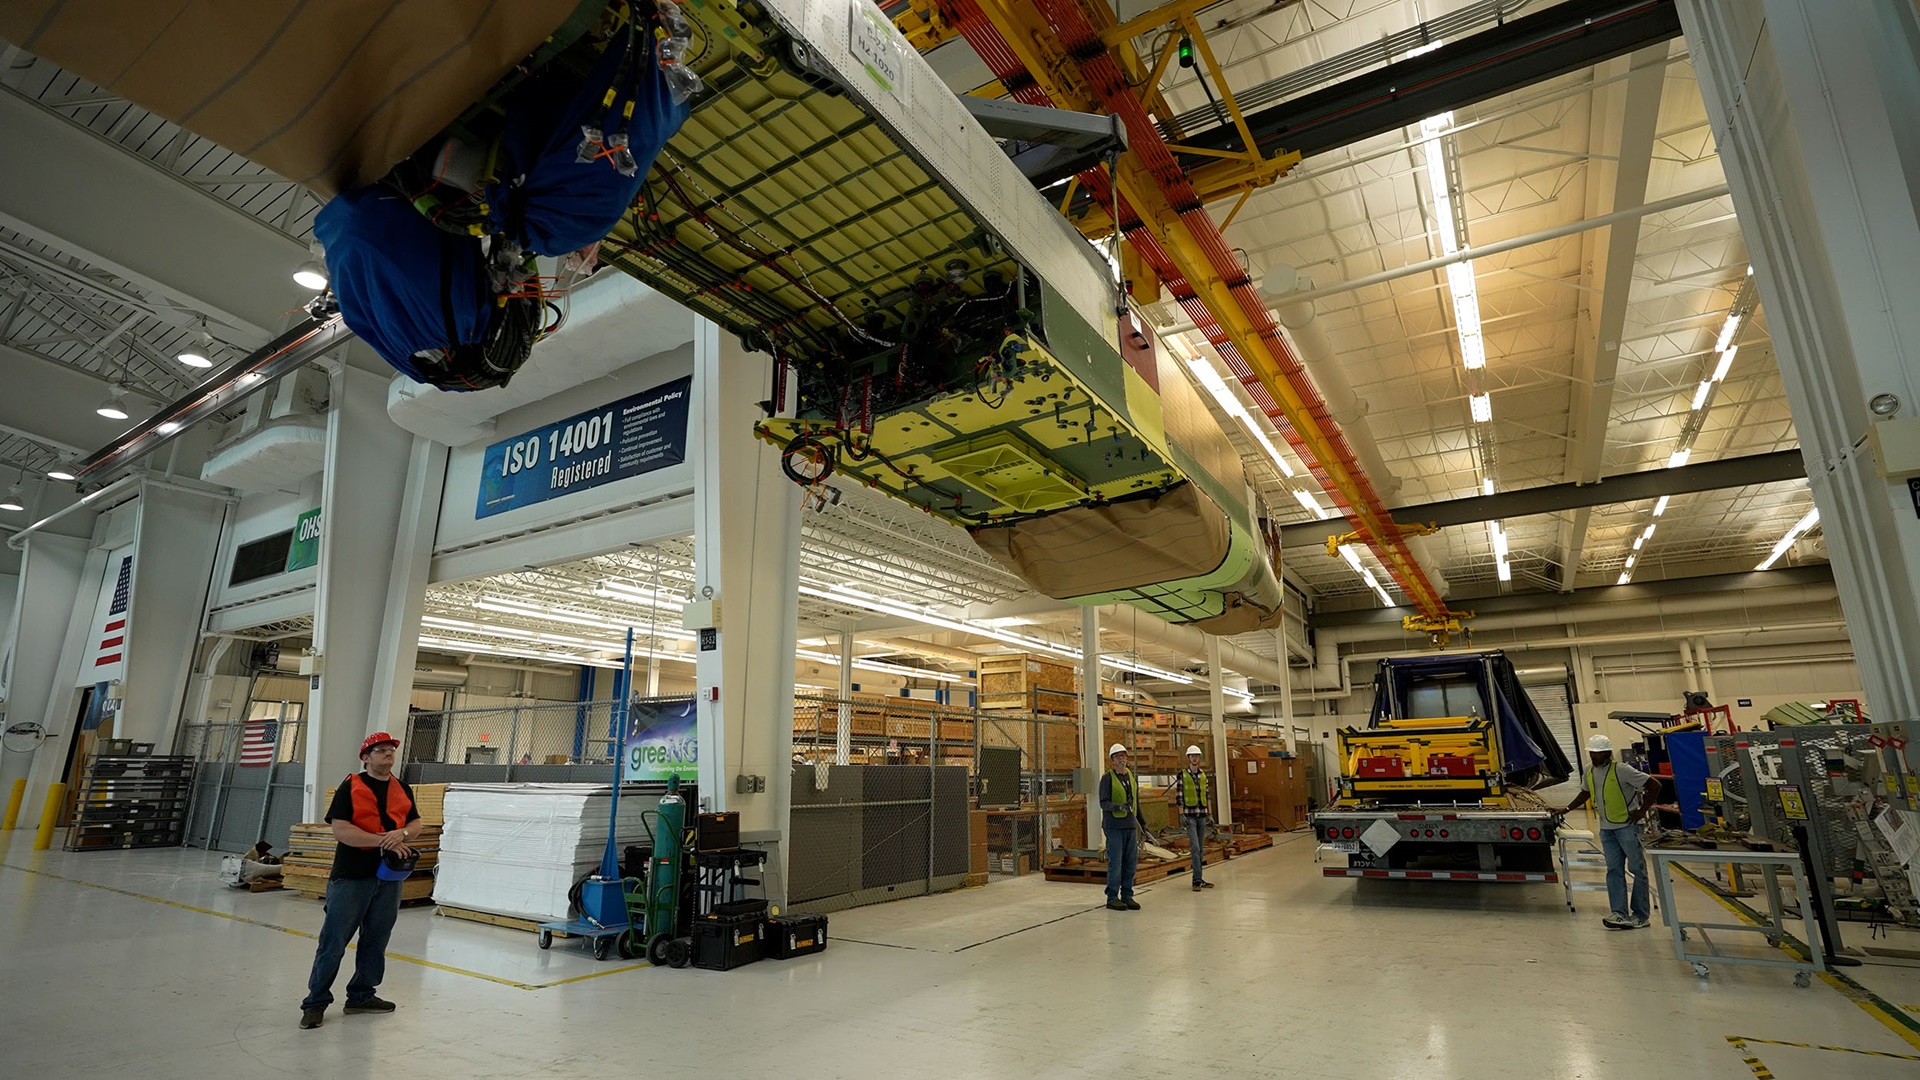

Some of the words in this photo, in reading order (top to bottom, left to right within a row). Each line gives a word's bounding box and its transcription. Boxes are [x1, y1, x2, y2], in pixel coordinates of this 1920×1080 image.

[623, 396, 663, 415] Environmental
[664, 391, 682, 402] Policy
[632, 410, 651, 421] compliance
[638, 430, 657, 440] prevention
[639, 437, 662, 448] improvement
[502, 435, 540, 477] ISO
[548, 412, 614, 462] 14001
[620, 453, 641, 462] Satisfaction
[646, 446, 663, 454] customer
[551, 450, 612, 489] Registered
